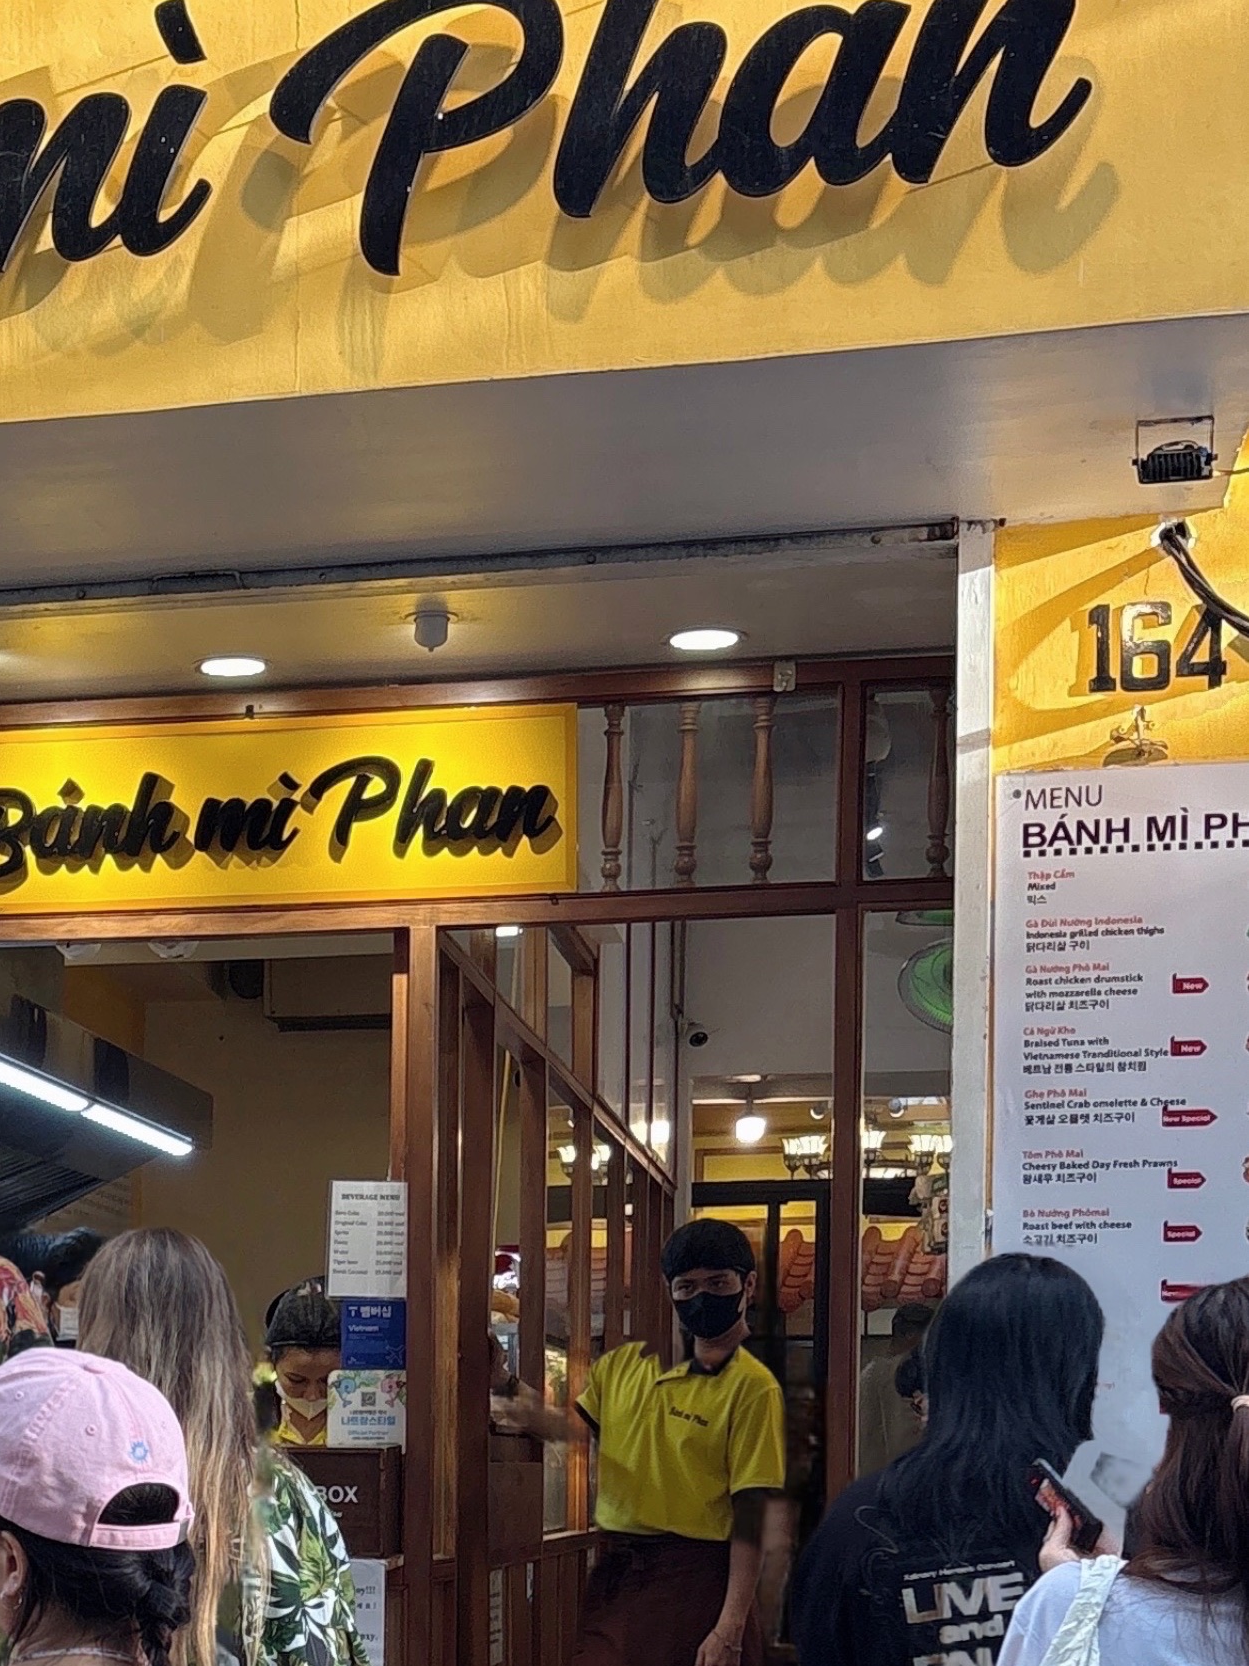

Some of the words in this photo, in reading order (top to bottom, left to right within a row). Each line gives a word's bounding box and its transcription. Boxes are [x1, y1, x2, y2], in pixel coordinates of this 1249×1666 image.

[268, 0, 1092, 275] Phan
[1088, 601, 1226, 692] 164
[1025, 785, 1102, 811] MENU
[195, 771, 300, 852] mì
[310, 755, 553, 860] Phan
[1023, 814, 1130, 848] BÁNH
[1146, 807, 1188, 842] MÌ
[1027, 882, 1056, 891] Mixed
[1095, 915, 1143, 925] Indonesia
[1026, 930, 1067, 939] Indonesia
[1069, 929, 1098, 940] grilled
[1101, 928, 1134, 937] chicken
[1137, 926, 1164, 937] thighs
[1026, 977, 1052, 986] Roast
[1054, 976, 1091, 984] chicken
[1094, 974, 1143, 983] drumstick
[1182, 982, 1204, 990] New
[1025, 990, 1047, 999] with
[1049, 989, 1102, 998] mozzarella
[1104, 987, 1138, 996] cheese
[1057, 1026, 1076, 1035] Kho
[1024, 1038, 1059, 1048] Braised
[1062, 1038, 1085, 1047] Tuna
[1087, 1037, 1109, 1046] with
[1180, 1044, 1202, 1052] New
[1023, 1051, 1080, 1061] Vietnamese
[1144, 1048, 1169, 1058] Style
[1024, 1100, 1065, 1110] Sentinel
[1067, 1099, 1091, 1109] Crab
[1092, 1098, 1138, 1107] omelette
[1140, 1098, 1148, 1106] &
[1150, 1097, 1186, 1107] Cheese
[1022, 1161, 1057, 1172] Cheesy
[1059, 1161, 1090, 1170] Baked
[1092, 1160, 1111, 1170] Day
[1113, 1159, 1140, 1168] Fresh
[1142, 1159, 1178, 1168] Prawns
[1022, 1221, 1049, 1230] Roast
[1051, 1220, 1073, 1229] beef
[1075, 1220, 1096, 1229] with
[1098, 1220, 1132, 1229] cheese
[314, 1485, 358, 1503] BOX
[902, 1572, 1024, 1624] LIVE
[939, 1613, 1005, 1644] and
